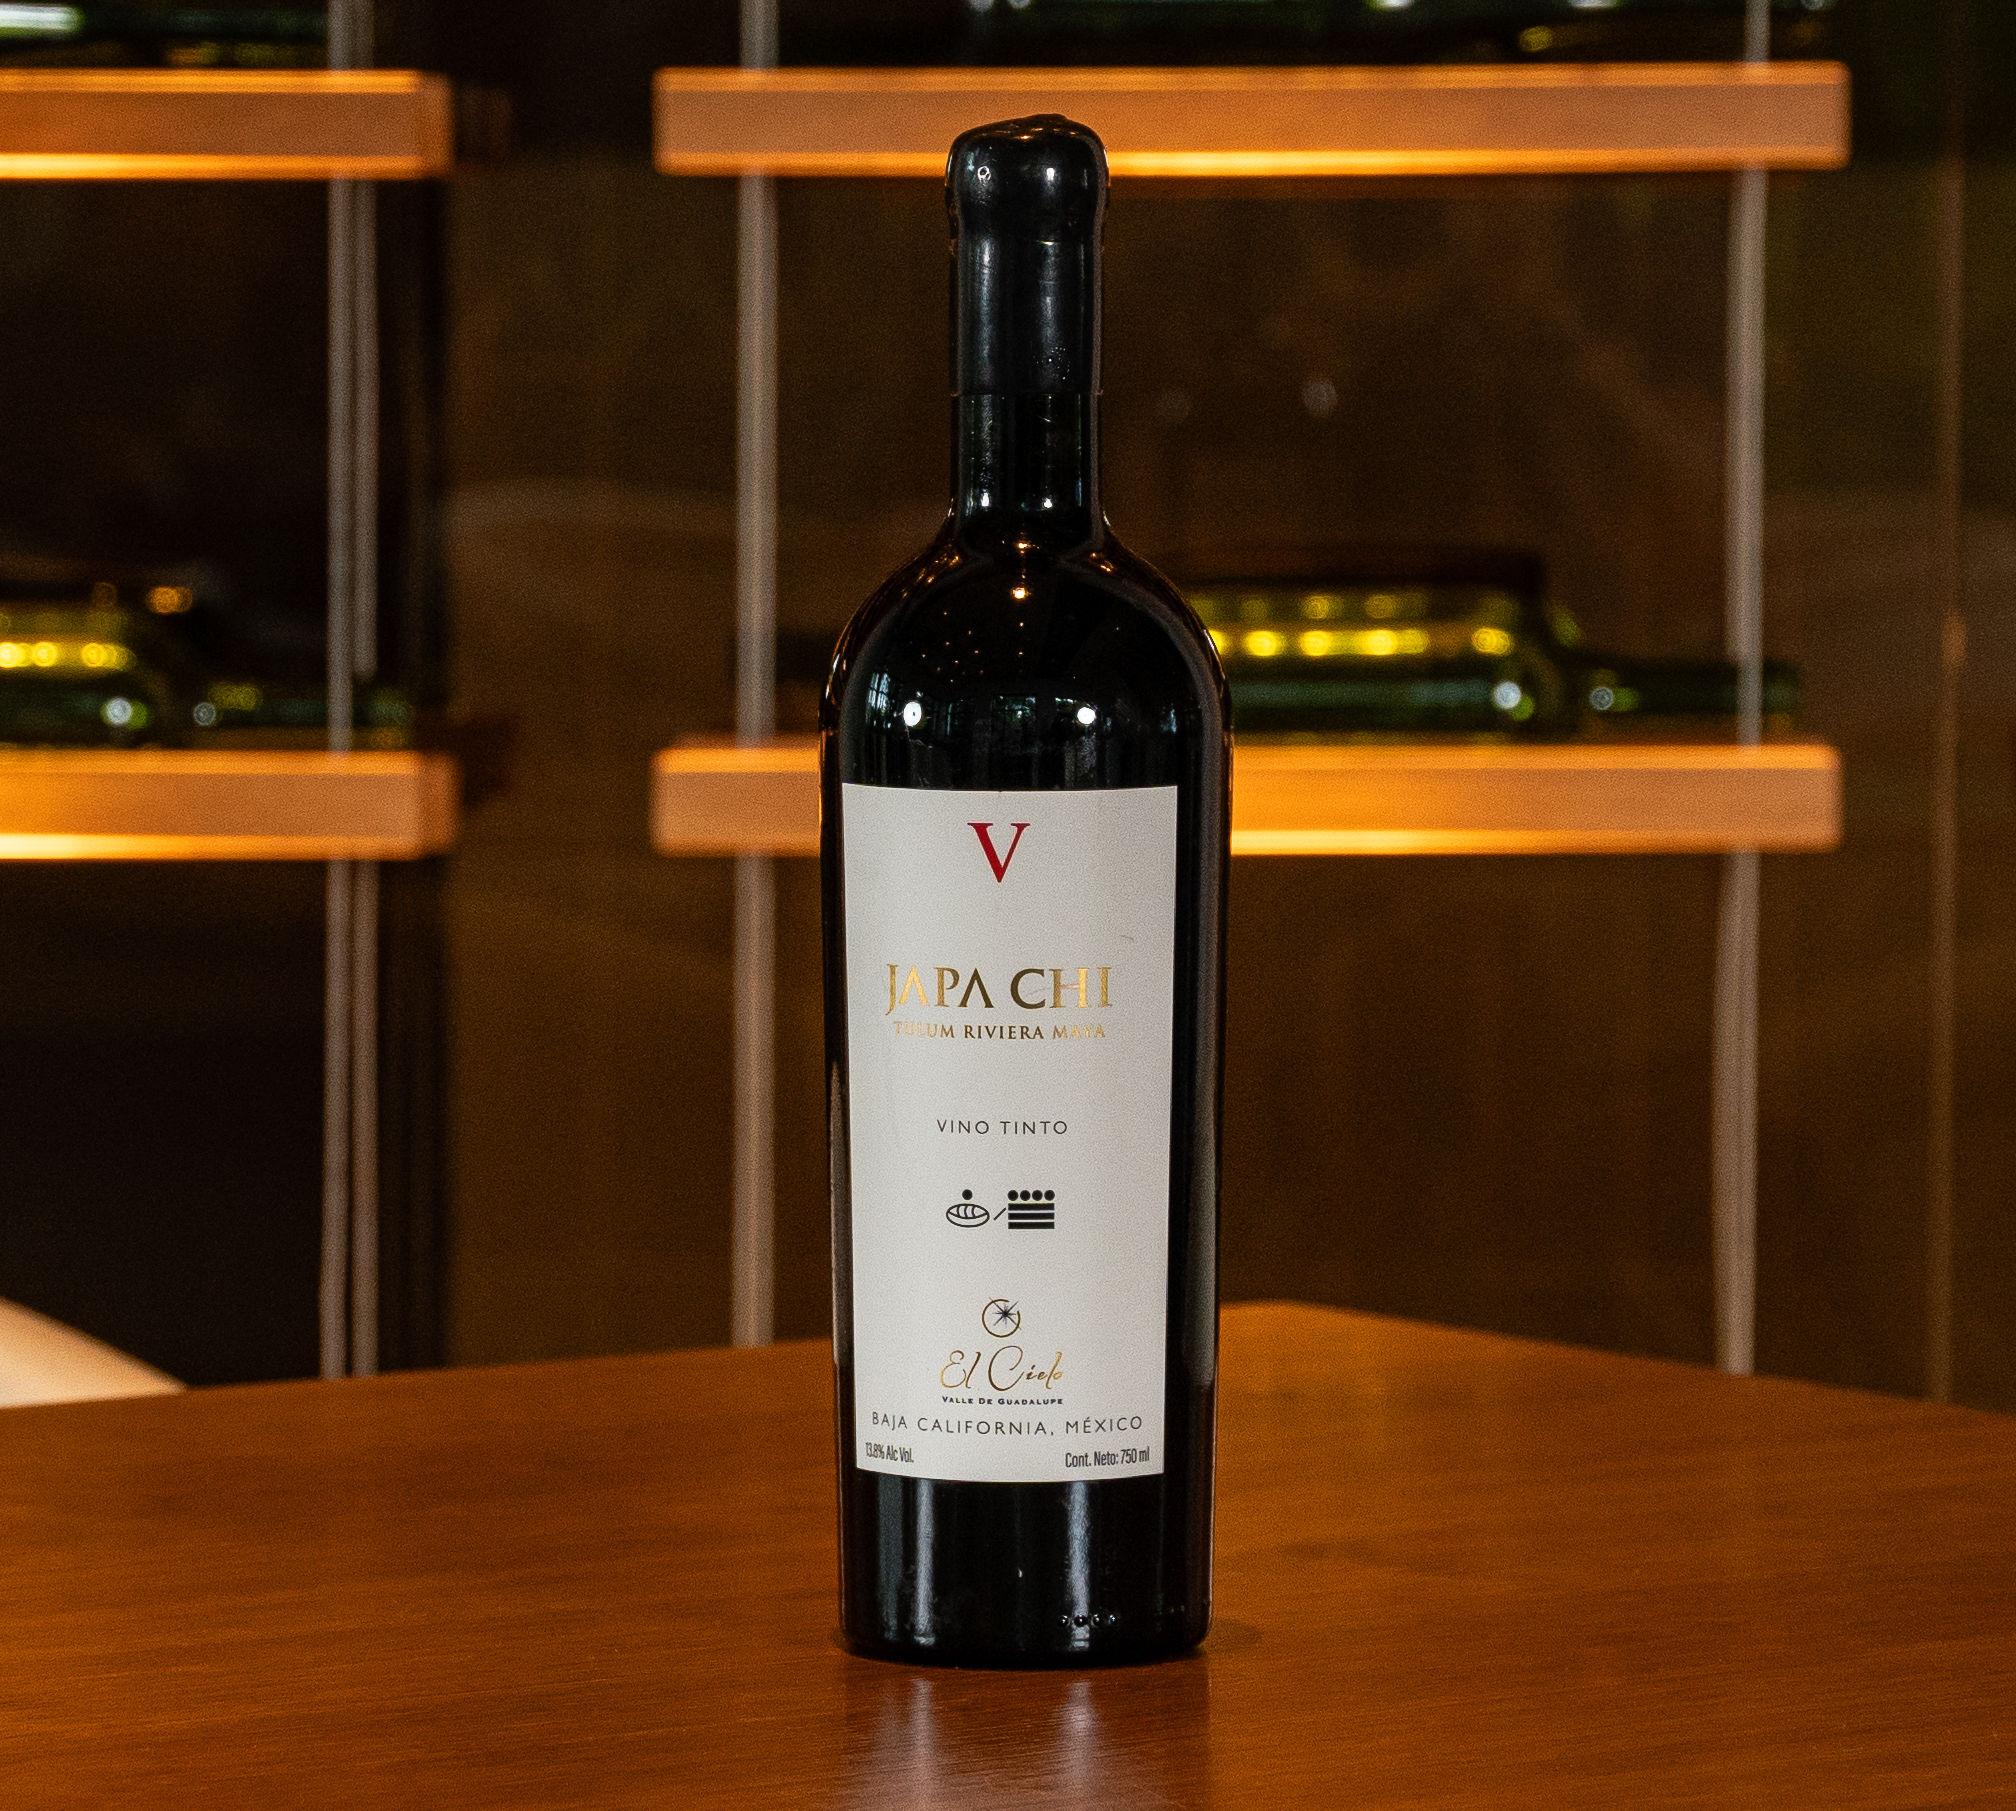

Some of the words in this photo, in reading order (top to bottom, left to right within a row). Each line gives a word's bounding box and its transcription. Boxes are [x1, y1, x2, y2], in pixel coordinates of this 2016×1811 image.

[967, 821, 1031, 883] V
[885, 963, 995, 1016] JAPA
[1010, 966, 1113, 1010] CHI
[893, 1020, 955, 1039] TULUM
[963, 1024, 1045, 1040] RIVIERA
[1052, 1024, 1107, 1039] MAYA
[936, 1118, 990, 1135] VINO
[999, 1120, 1068, 1135] TINTO
[939, 1350, 982, 1389] El
[988, 1345, 1064, 1392] Cielo
[872, 1411, 908, 1431] BAJA
[917, 1417, 1054, 1436] CALIFORNIA,
[1065, 1415, 1143, 1434] MÉXICO
[1065, 1451, 1092, 1468] Cont.
[1093, 1450, 1119, 1467] Neto:
[1120, 1448, 1138, 1465] 750
[1139, 1445, 1150, 1463] ml
